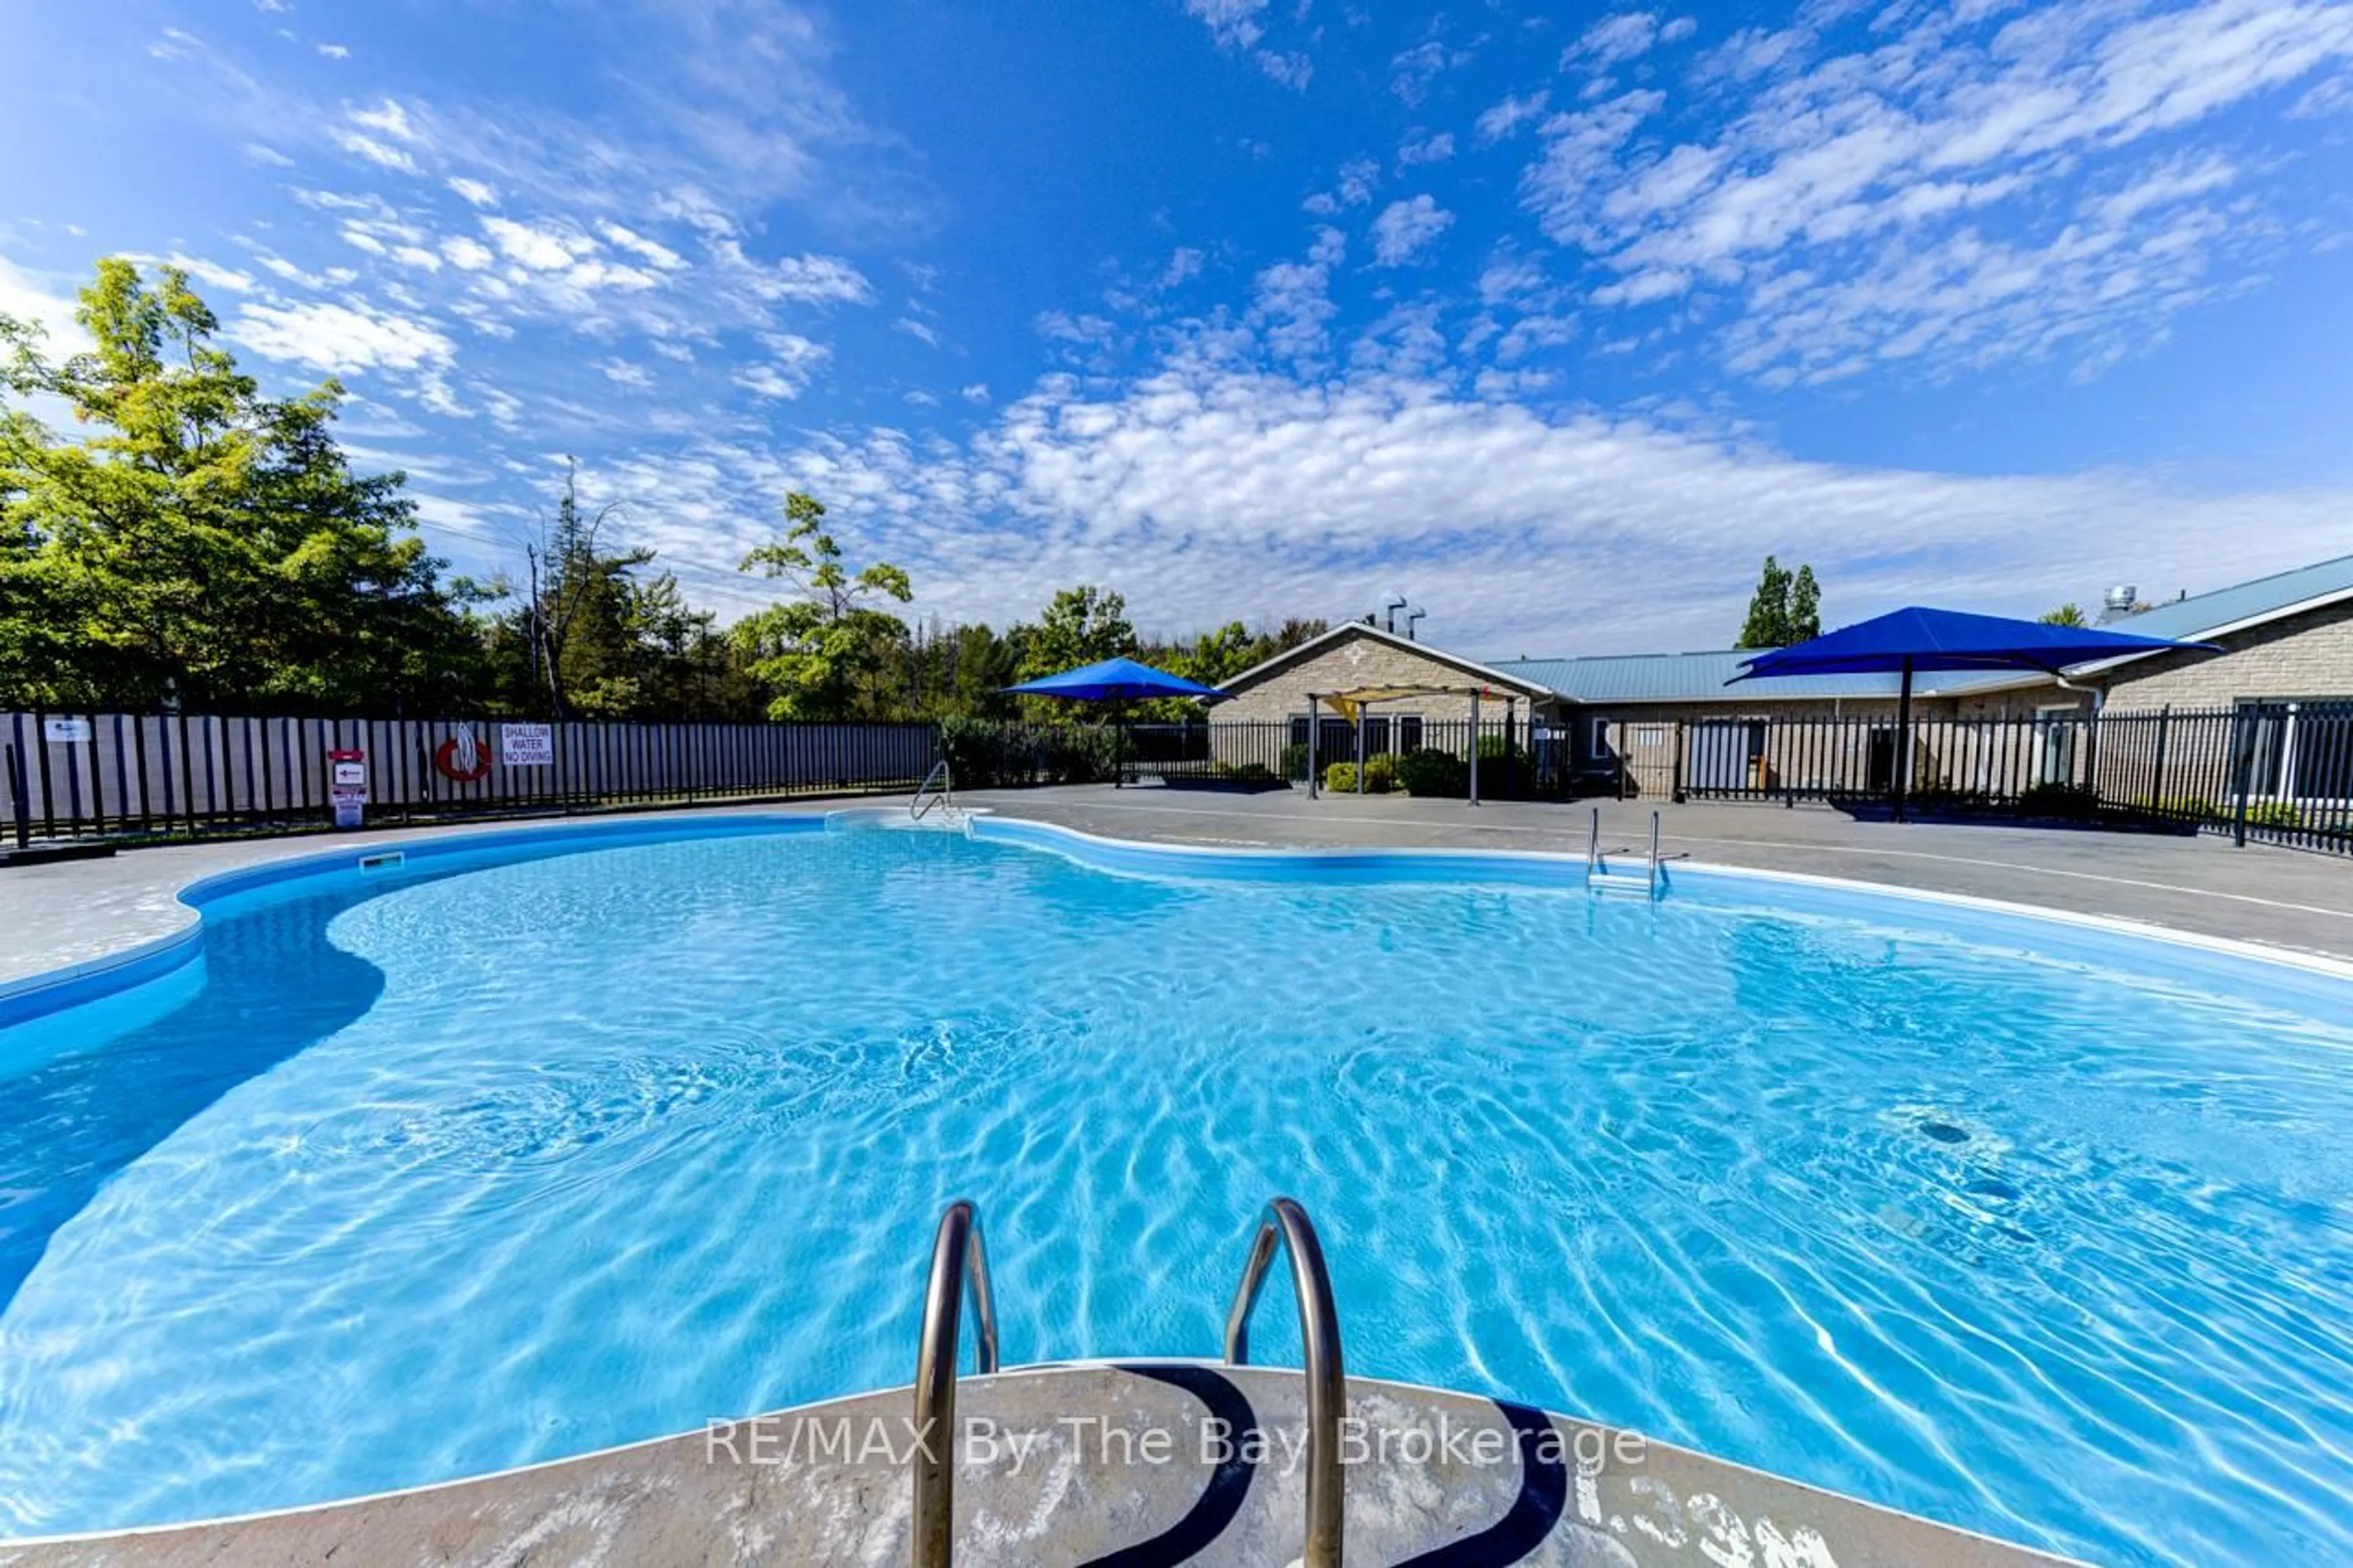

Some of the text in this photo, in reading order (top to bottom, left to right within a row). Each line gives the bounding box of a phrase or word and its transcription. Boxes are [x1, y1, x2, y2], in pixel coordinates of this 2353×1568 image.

[505, 726, 550, 738] SHALLOW
[513, 739, 543, 749] WATER
[505, 751, 551, 762] NO DIVING
